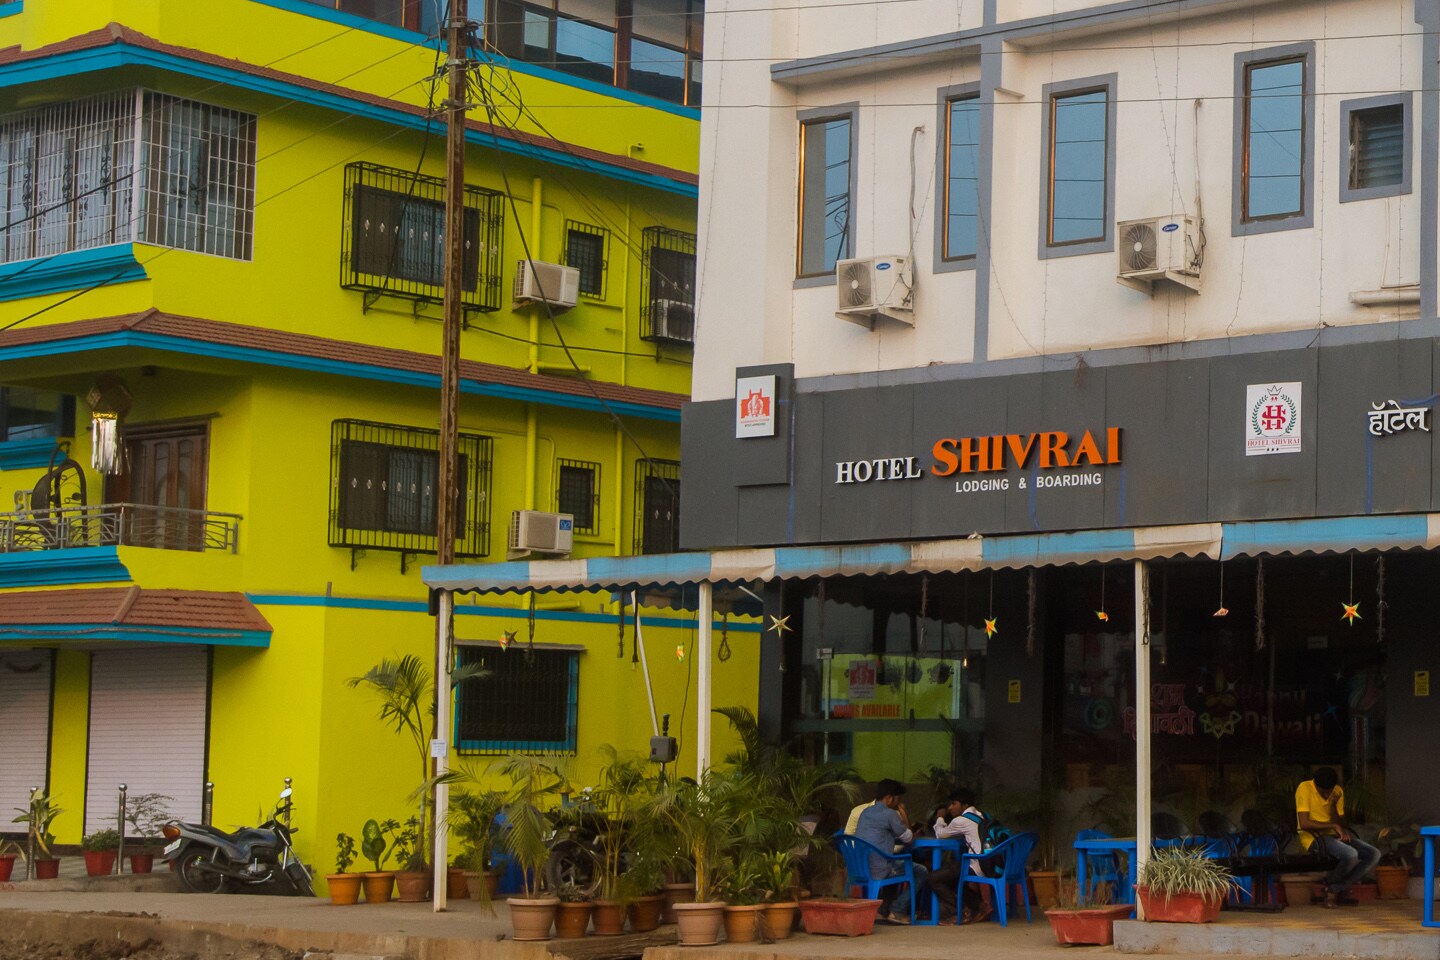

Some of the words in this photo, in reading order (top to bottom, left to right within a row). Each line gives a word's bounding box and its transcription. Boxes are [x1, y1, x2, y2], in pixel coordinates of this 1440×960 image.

[1368, 400, 1431, 436] हॉटेल
[835, 455, 922, 484] HOTEL
[930, 427, 1122, 476] SHIVRAI
[1271, 438, 1300, 446] SHIVRAI
[955, 478, 1010, 493] LODGING
[1018, 477, 1027, 489] &
[1036, 472, 1102, 489] BOARDING
